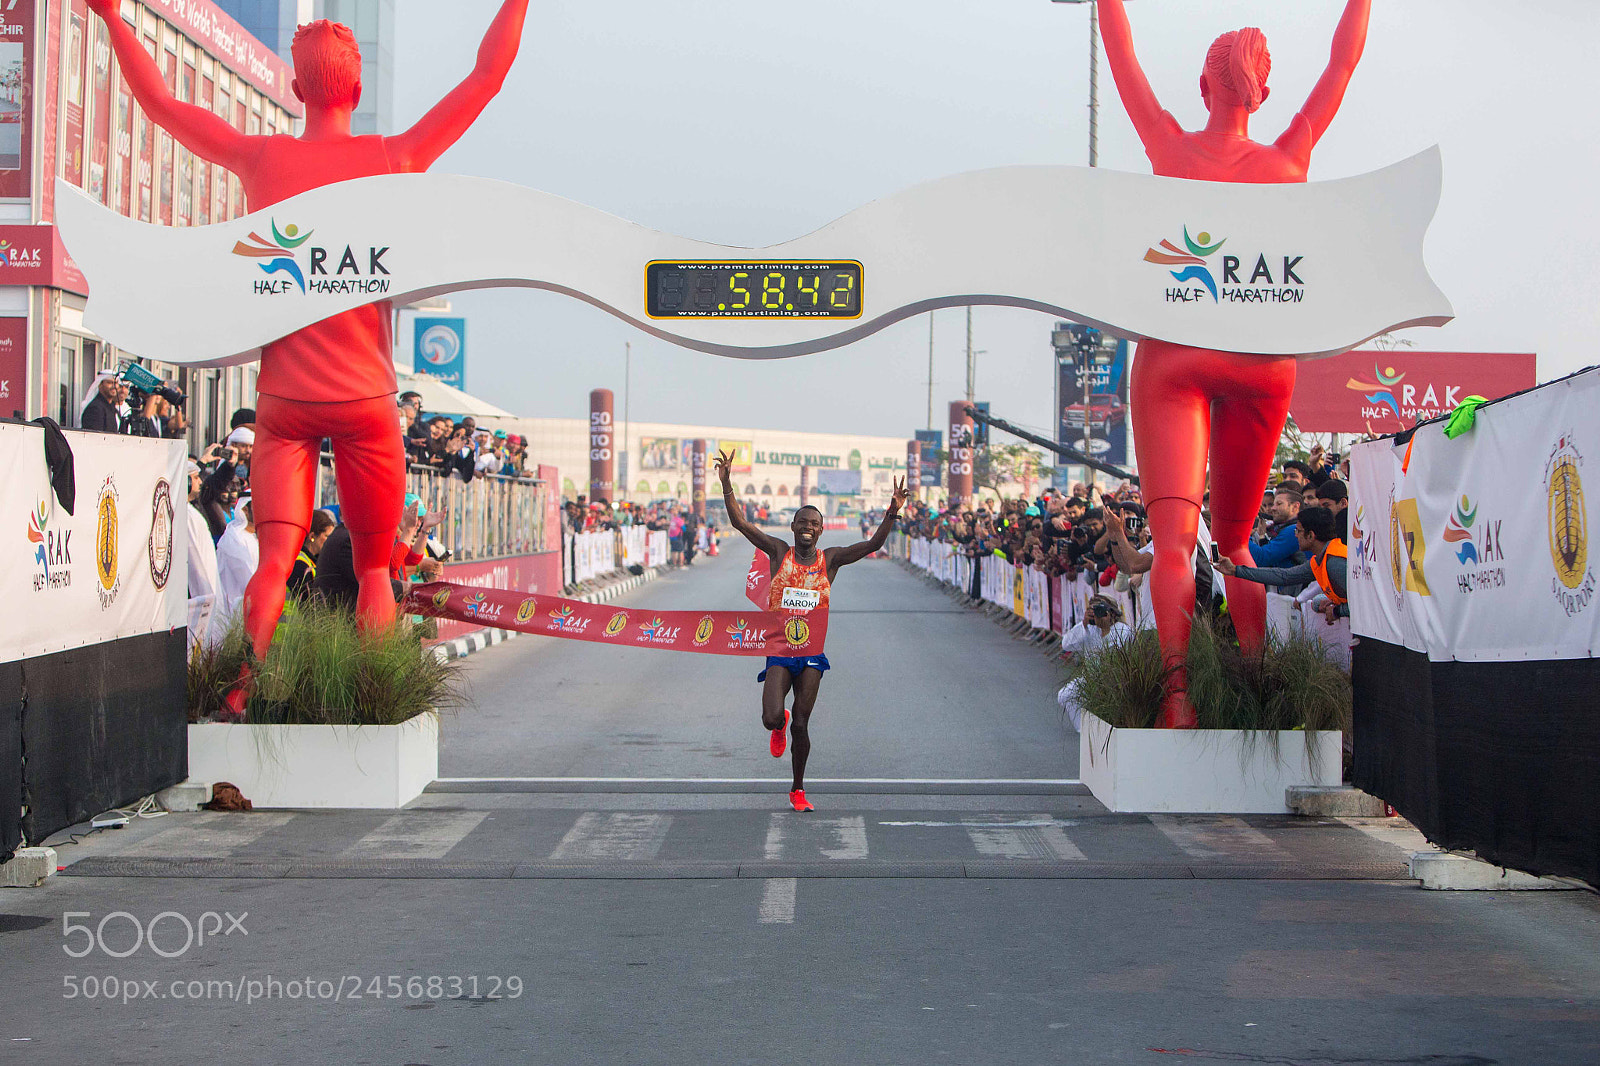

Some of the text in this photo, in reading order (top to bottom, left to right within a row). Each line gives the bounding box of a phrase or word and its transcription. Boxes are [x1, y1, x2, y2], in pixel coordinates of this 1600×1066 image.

[248, 44, 274, 87] Marathon
[10, 248, 41, 261] RAK
[310, 244, 391, 275] RAK
[1223, 252, 1305, 285] RAK
[254, 279, 390, 295] HALF MARATHON
[1166, 287, 1304, 303] HALF MARATHON
[1403, 383, 1461, 408] RAK
[591, 412, 611, 426] 50
[1362, 407, 1453, 419] HALF MARATHO
[951, 424, 972, 438] 50
[592, 434, 610, 447] TO
[590, 448, 611, 461] GO
[755, 451, 766, 464] AL
[769, 452, 802, 466] SAFEER
[804, 454, 840, 468] MARKET
[951, 447, 970, 460] TO
[950, 462, 971, 475] GO
[49, 527, 71, 565] RAK
[479, 602, 504, 615] RAK
[783, 599, 817, 608] KAROKI
[565, 616, 591, 629] RAK
[656, 626, 681, 638] RAK
[744, 628, 767, 641] RAK
